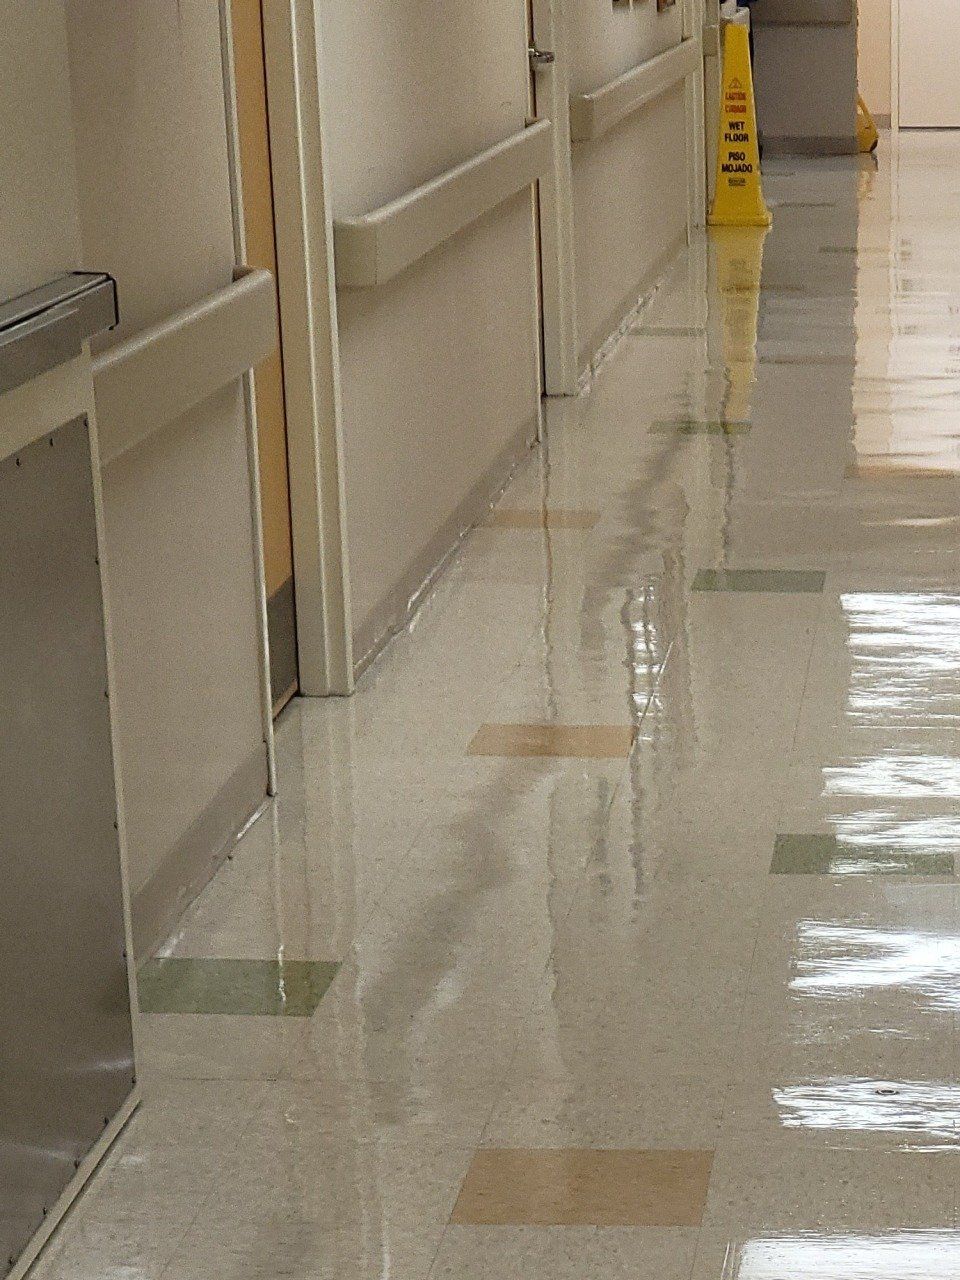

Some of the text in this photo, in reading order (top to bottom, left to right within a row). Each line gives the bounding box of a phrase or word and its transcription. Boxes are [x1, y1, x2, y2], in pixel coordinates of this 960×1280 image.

[729, 121, 745, 131] WET
[725, 133, 749, 142] FLOOR
[729, 152, 745, 161] PISO
[722, 163, 752, 173] MOJADO
